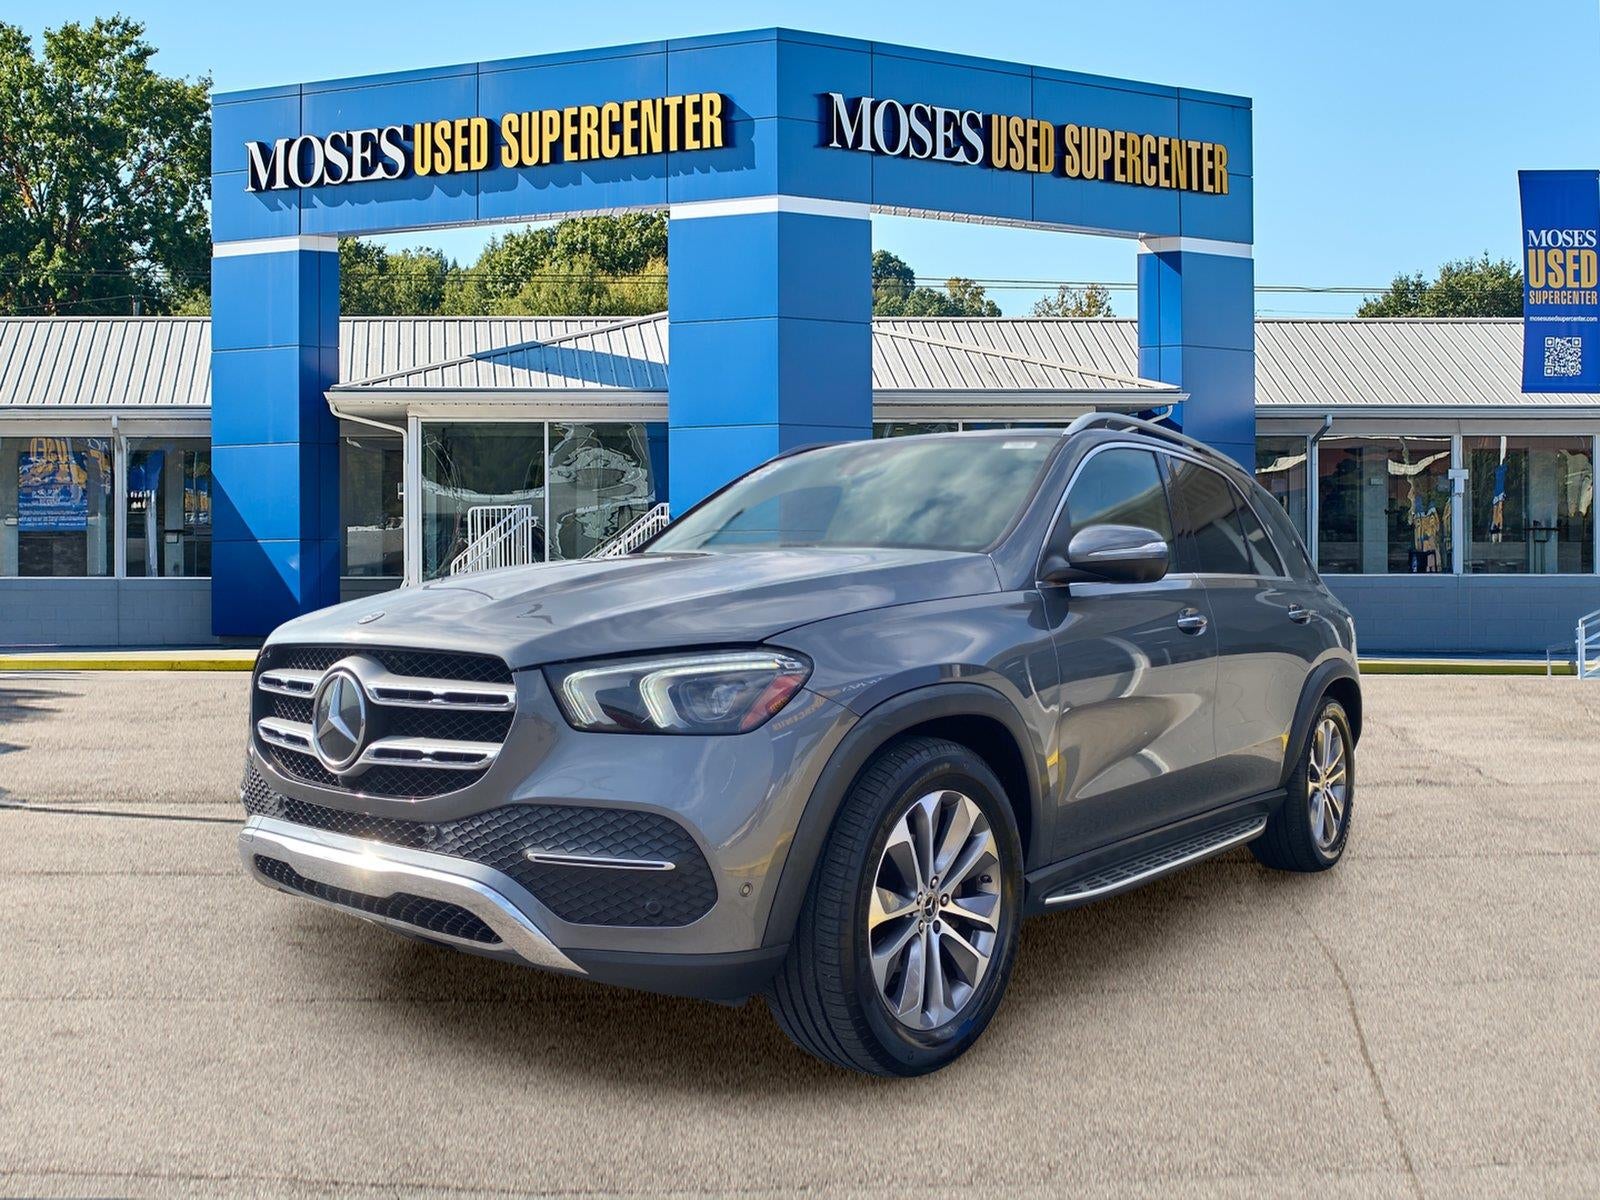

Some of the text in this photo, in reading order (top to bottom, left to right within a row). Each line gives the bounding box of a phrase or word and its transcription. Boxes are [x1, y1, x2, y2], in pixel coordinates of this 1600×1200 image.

[244, 92, 723, 192] MOSES USED SUPERCENTER
[828, 92, 1229, 194] MOSES USED SUPERCENTER
[1527, 229, 1597, 247] MOSES
[1528, 249, 1598, 288] USED
[1529, 290, 1598, 305] SUPERCENTER
